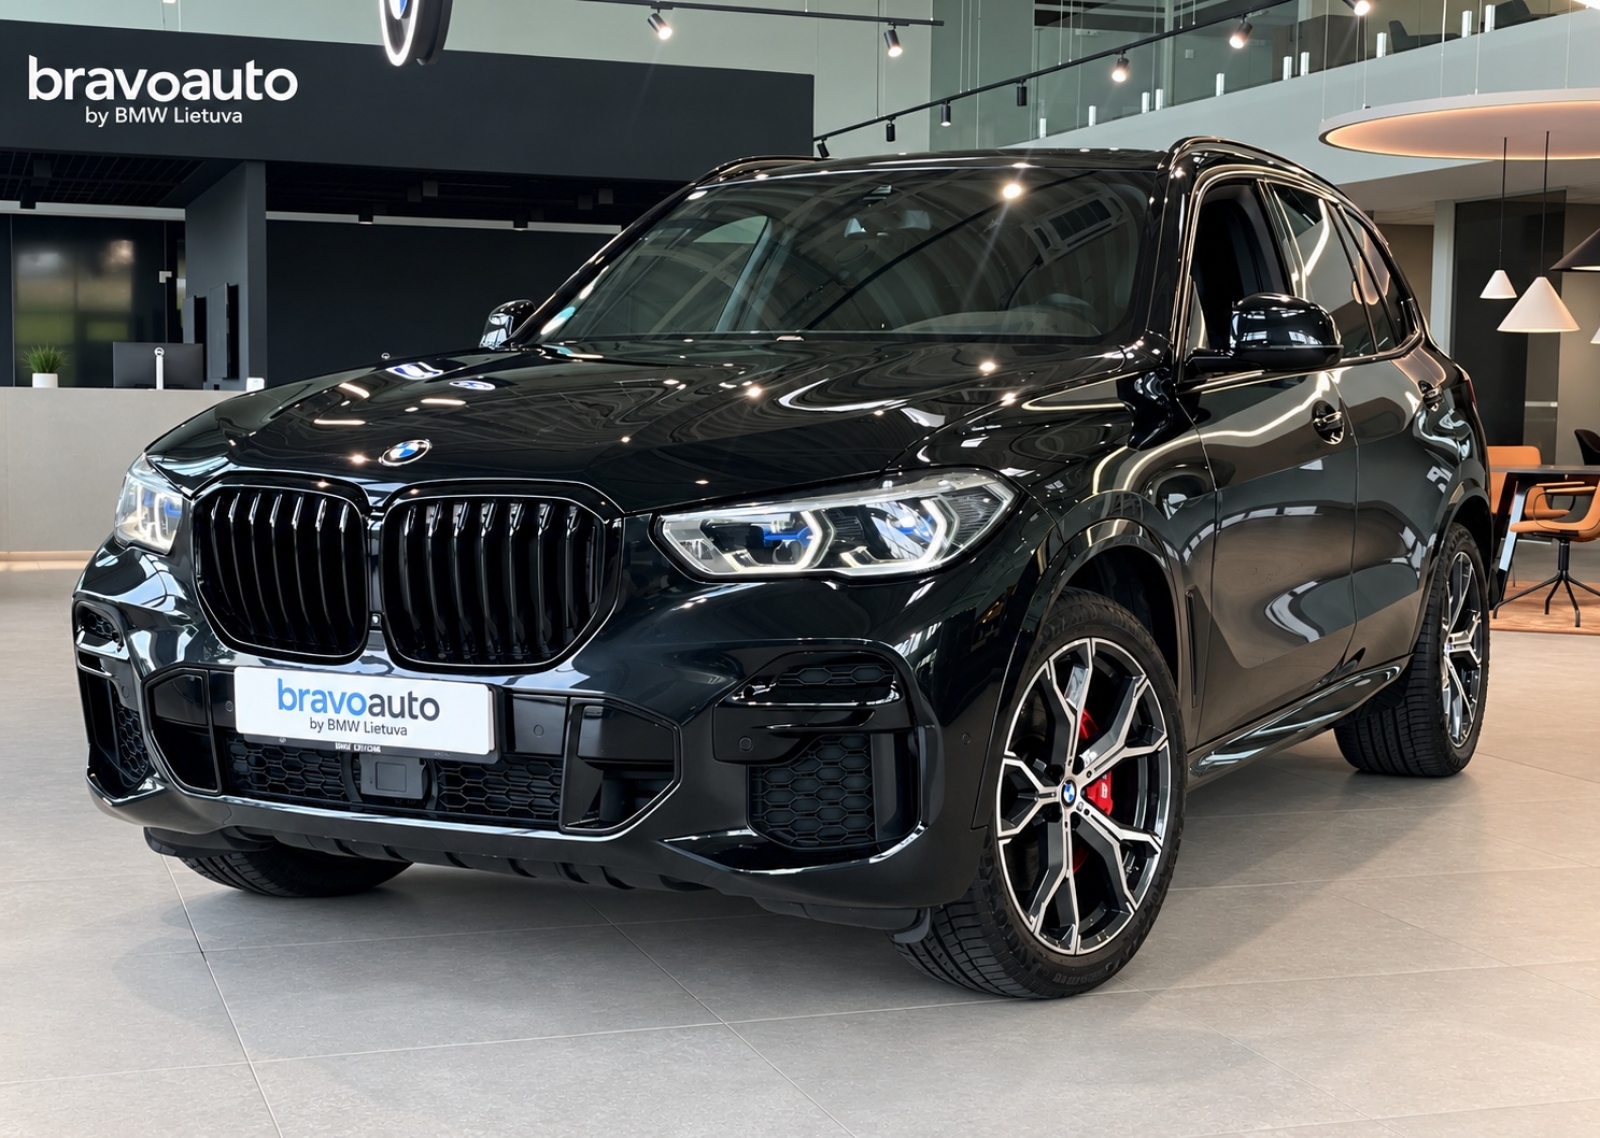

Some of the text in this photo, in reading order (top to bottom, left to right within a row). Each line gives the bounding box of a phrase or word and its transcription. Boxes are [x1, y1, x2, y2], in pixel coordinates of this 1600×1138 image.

[28, 54, 299, 103] bravoauto
[85, 106, 243, 128] by BMW Lietuva
[277, 677, 440, 722] bravoauto
[309, 716, 408, 736] by BMW Lietuva
